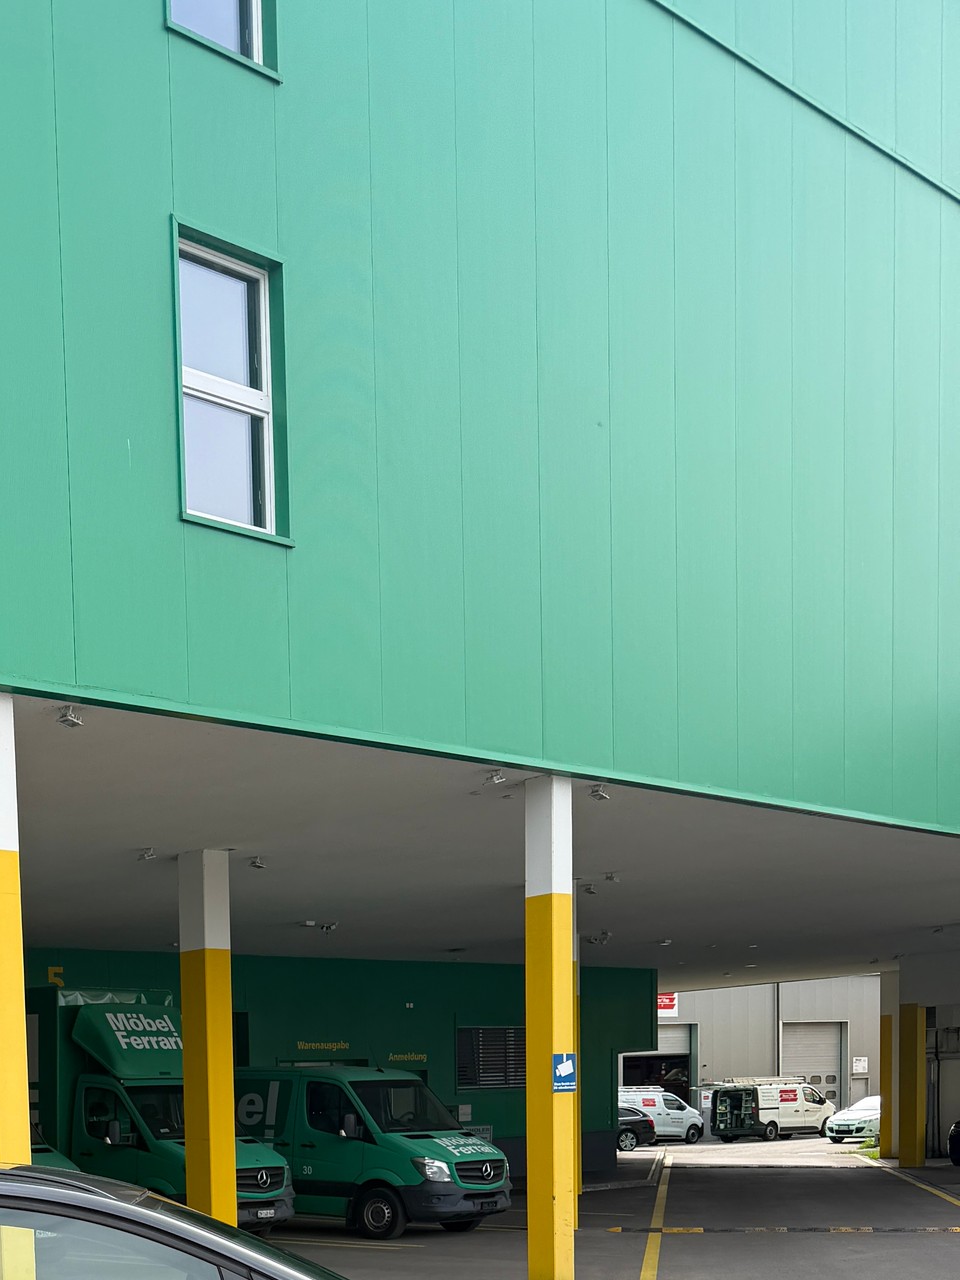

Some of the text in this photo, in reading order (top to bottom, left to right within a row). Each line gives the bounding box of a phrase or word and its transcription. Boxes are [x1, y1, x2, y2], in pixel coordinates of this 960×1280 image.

[48, 966, 65, 987] 5
[105, 1012, 176, 1032] Möbel
[114, 1031, 183, 1050] Ferrari
[297, 1041, 350, 1051] Warenausgabe
[388, 1052, 428, 1063] Anmeldung
[446, 1145, 499, 1157] Ferrari
[302, 1165, 313, 1175] 30
